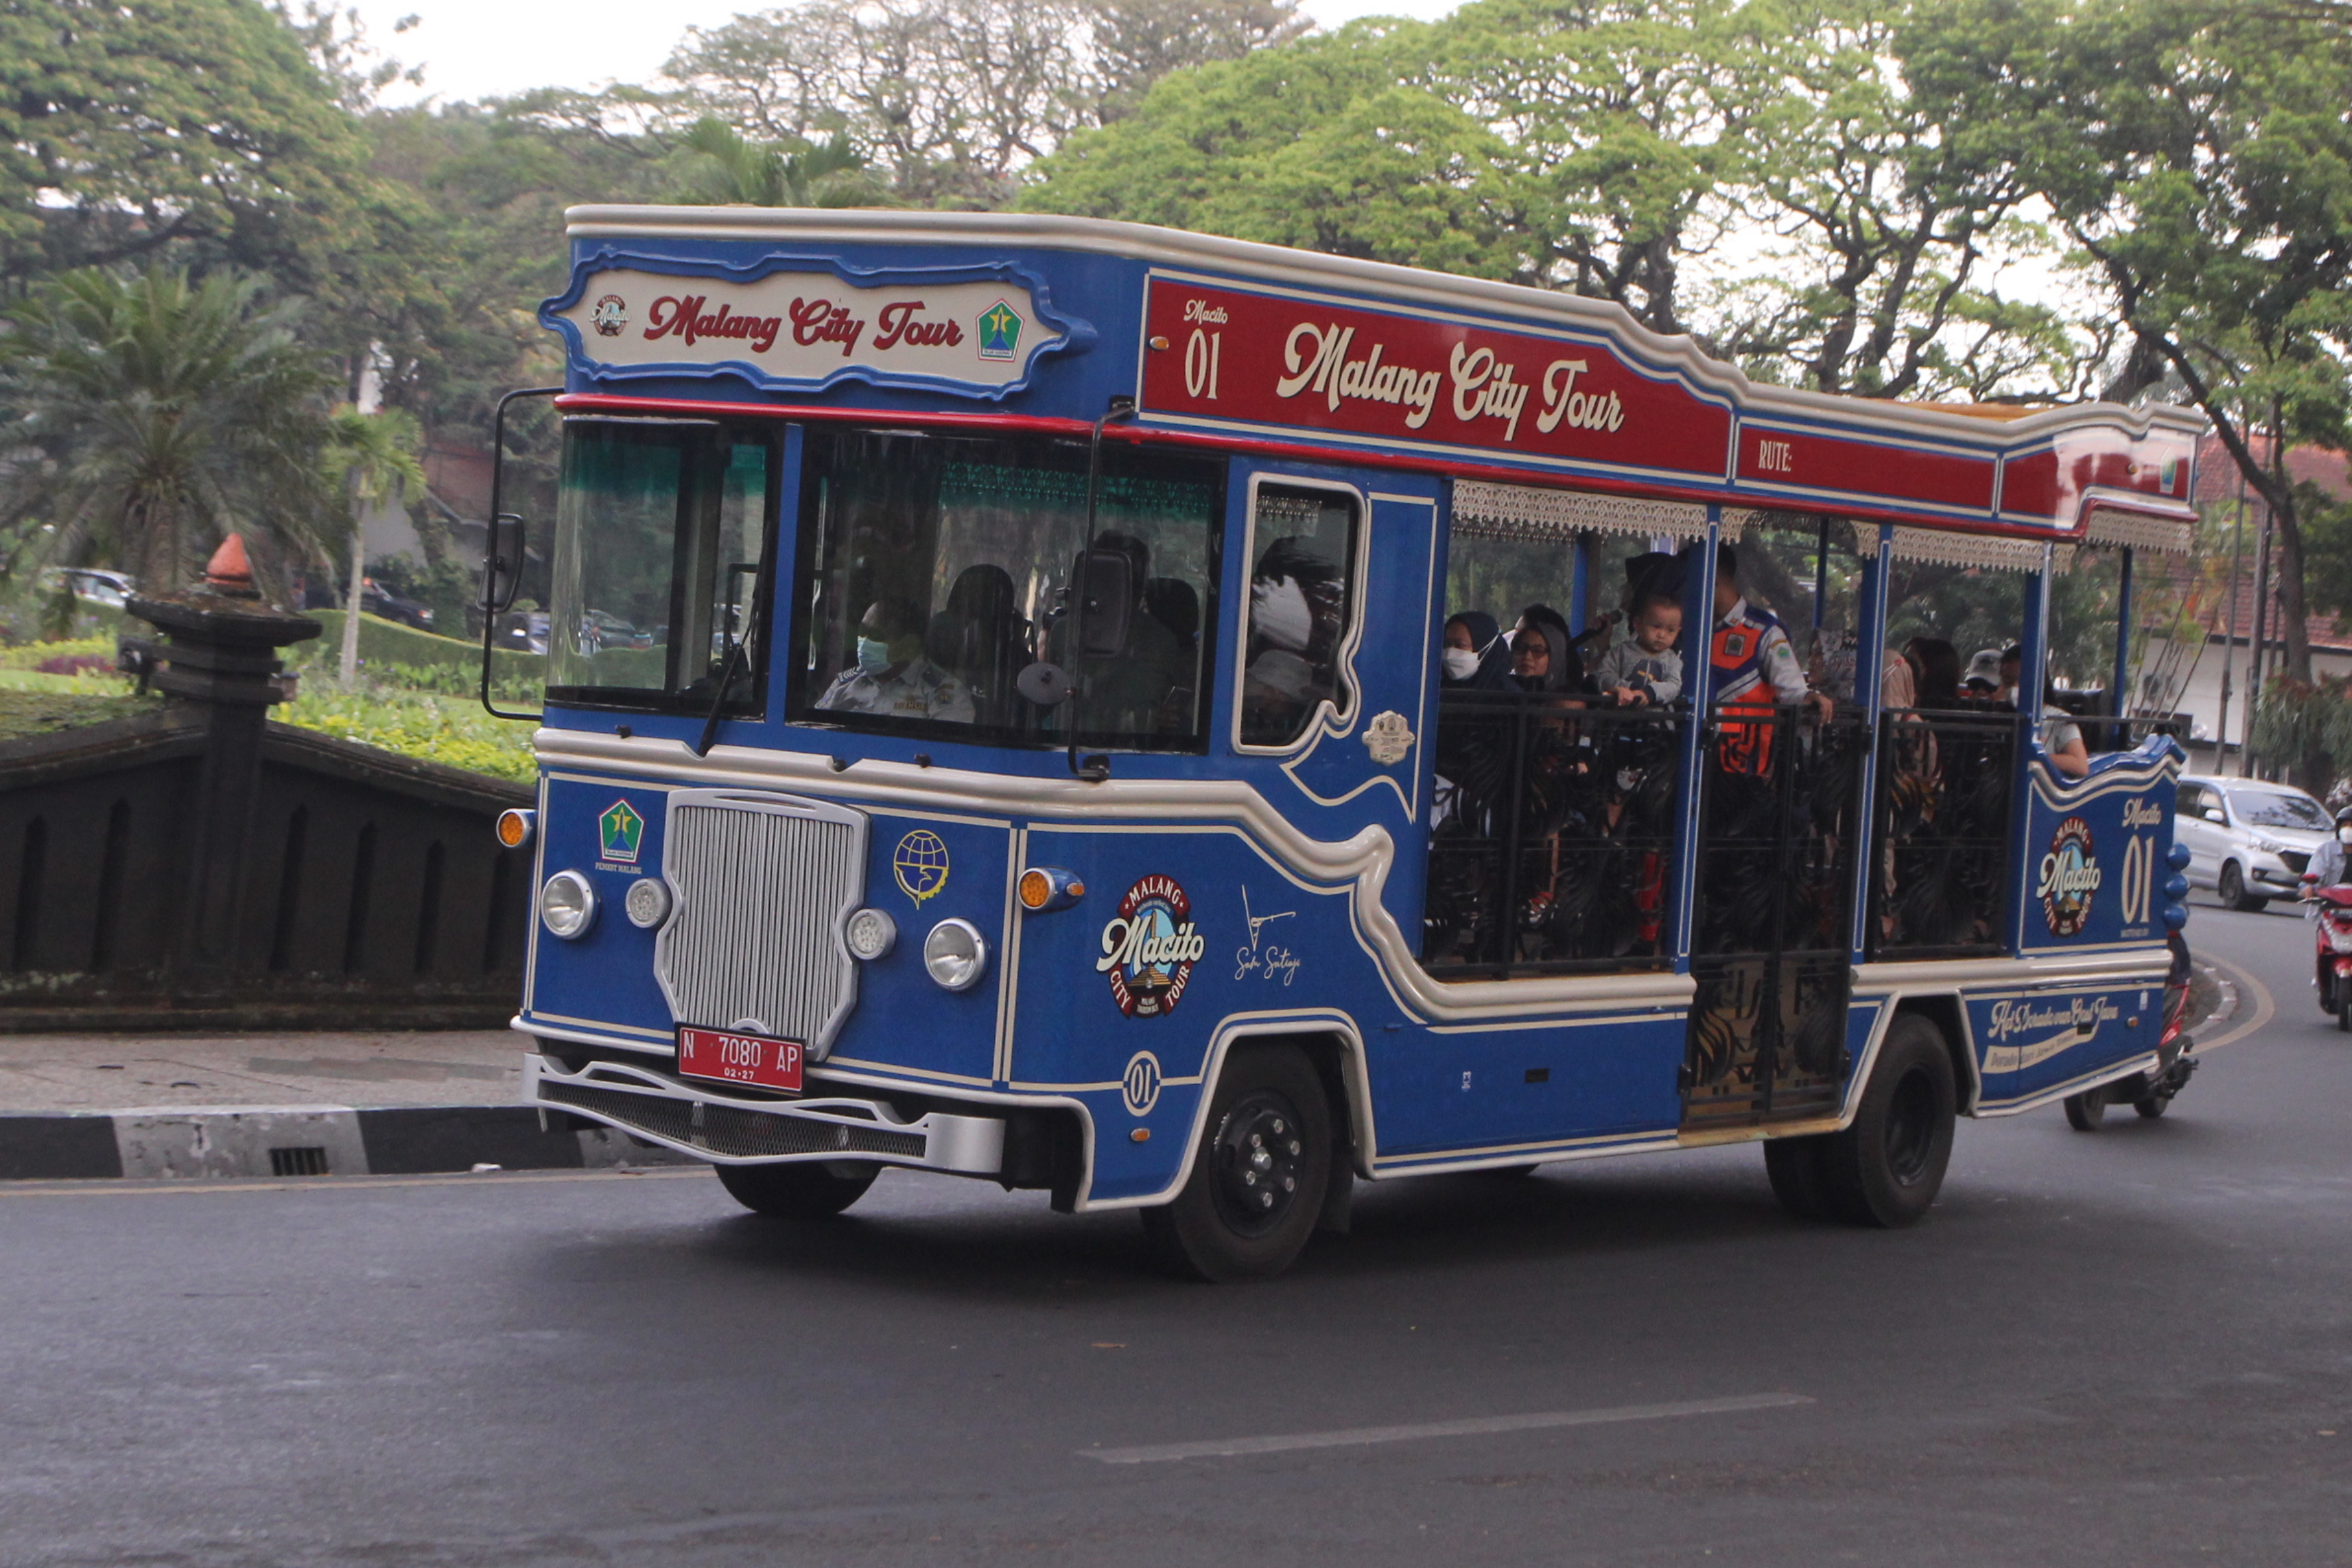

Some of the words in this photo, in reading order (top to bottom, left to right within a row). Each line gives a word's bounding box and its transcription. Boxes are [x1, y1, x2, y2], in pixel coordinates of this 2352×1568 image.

[643, 295, 781, 353] Malang
[789, 297, 864, 356] City
[872, 301, 964, 350] Tour
[1183, 299, 1228, 324] Macito
[1184, 328, 1220, 399] 01
[1277, 322, 1441, 429] Malang
[1450, 341, 1529, 442] City
[1536, 359, 1624, 433] Tour
[1759, 440, 1793, 472] RUTE:
[2056, 818, 2089, 843] MALANG
[2122, 798, 2161, 830] Macito
[618, 865, 642, 875] MALANG
[2036, 852, 2101, 902] Macito
[2121, 834, 2154, 924] 01
[1128, 877, 1181, 906] MALANG
[2044, 897, 2056, 929] CITY
[2076, 894, 2092, 928] TOUR
[1096, 915, 1204, 975] Macito
[1110, 970, 1130, 1009] CITY
[1165, 965, 1190, 1007] TOUR
[683, 1032, 694, 1058] N
[719, 1036, 761, 1067] 7080
[776, 1045, 798, 1072] AP
[1130, 1064, 1152, 1104] 01
